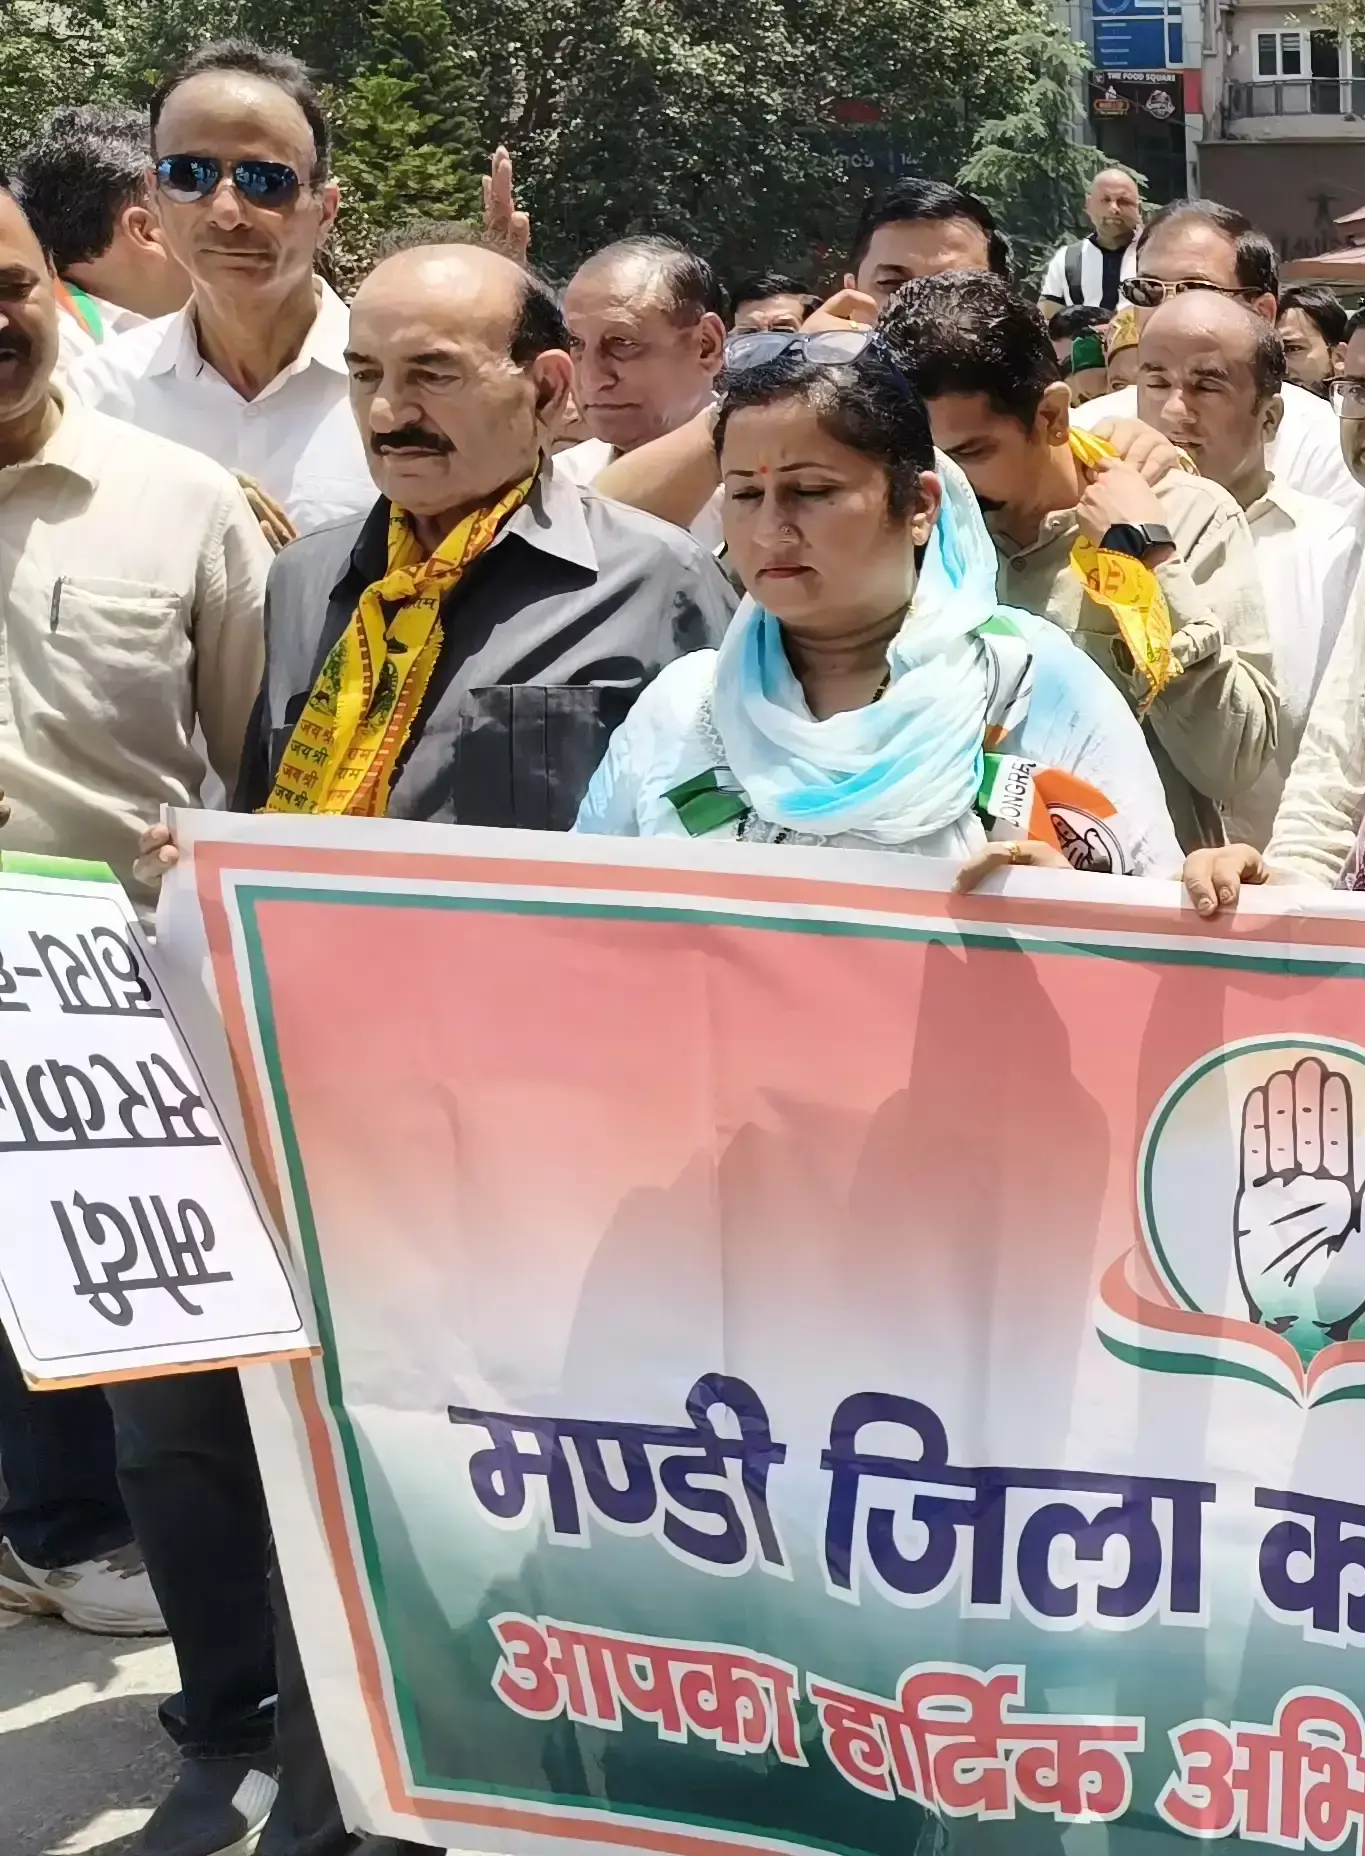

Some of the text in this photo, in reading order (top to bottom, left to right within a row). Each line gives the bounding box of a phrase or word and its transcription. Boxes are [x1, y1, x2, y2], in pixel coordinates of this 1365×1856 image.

[1107, 72, 1176, 83] THE FOOD SQUARE
[0, 1053, 221, 1152] सरका
[51, 1189, 234, 1328] मोदी
[448, 1372, 787, 1567] मण्डी
[820, 1391, 1217, 1617] जिला
[497, 1617, 804, 1764] आपका
[810, 1668, 1142, 1817] हार्दिक
